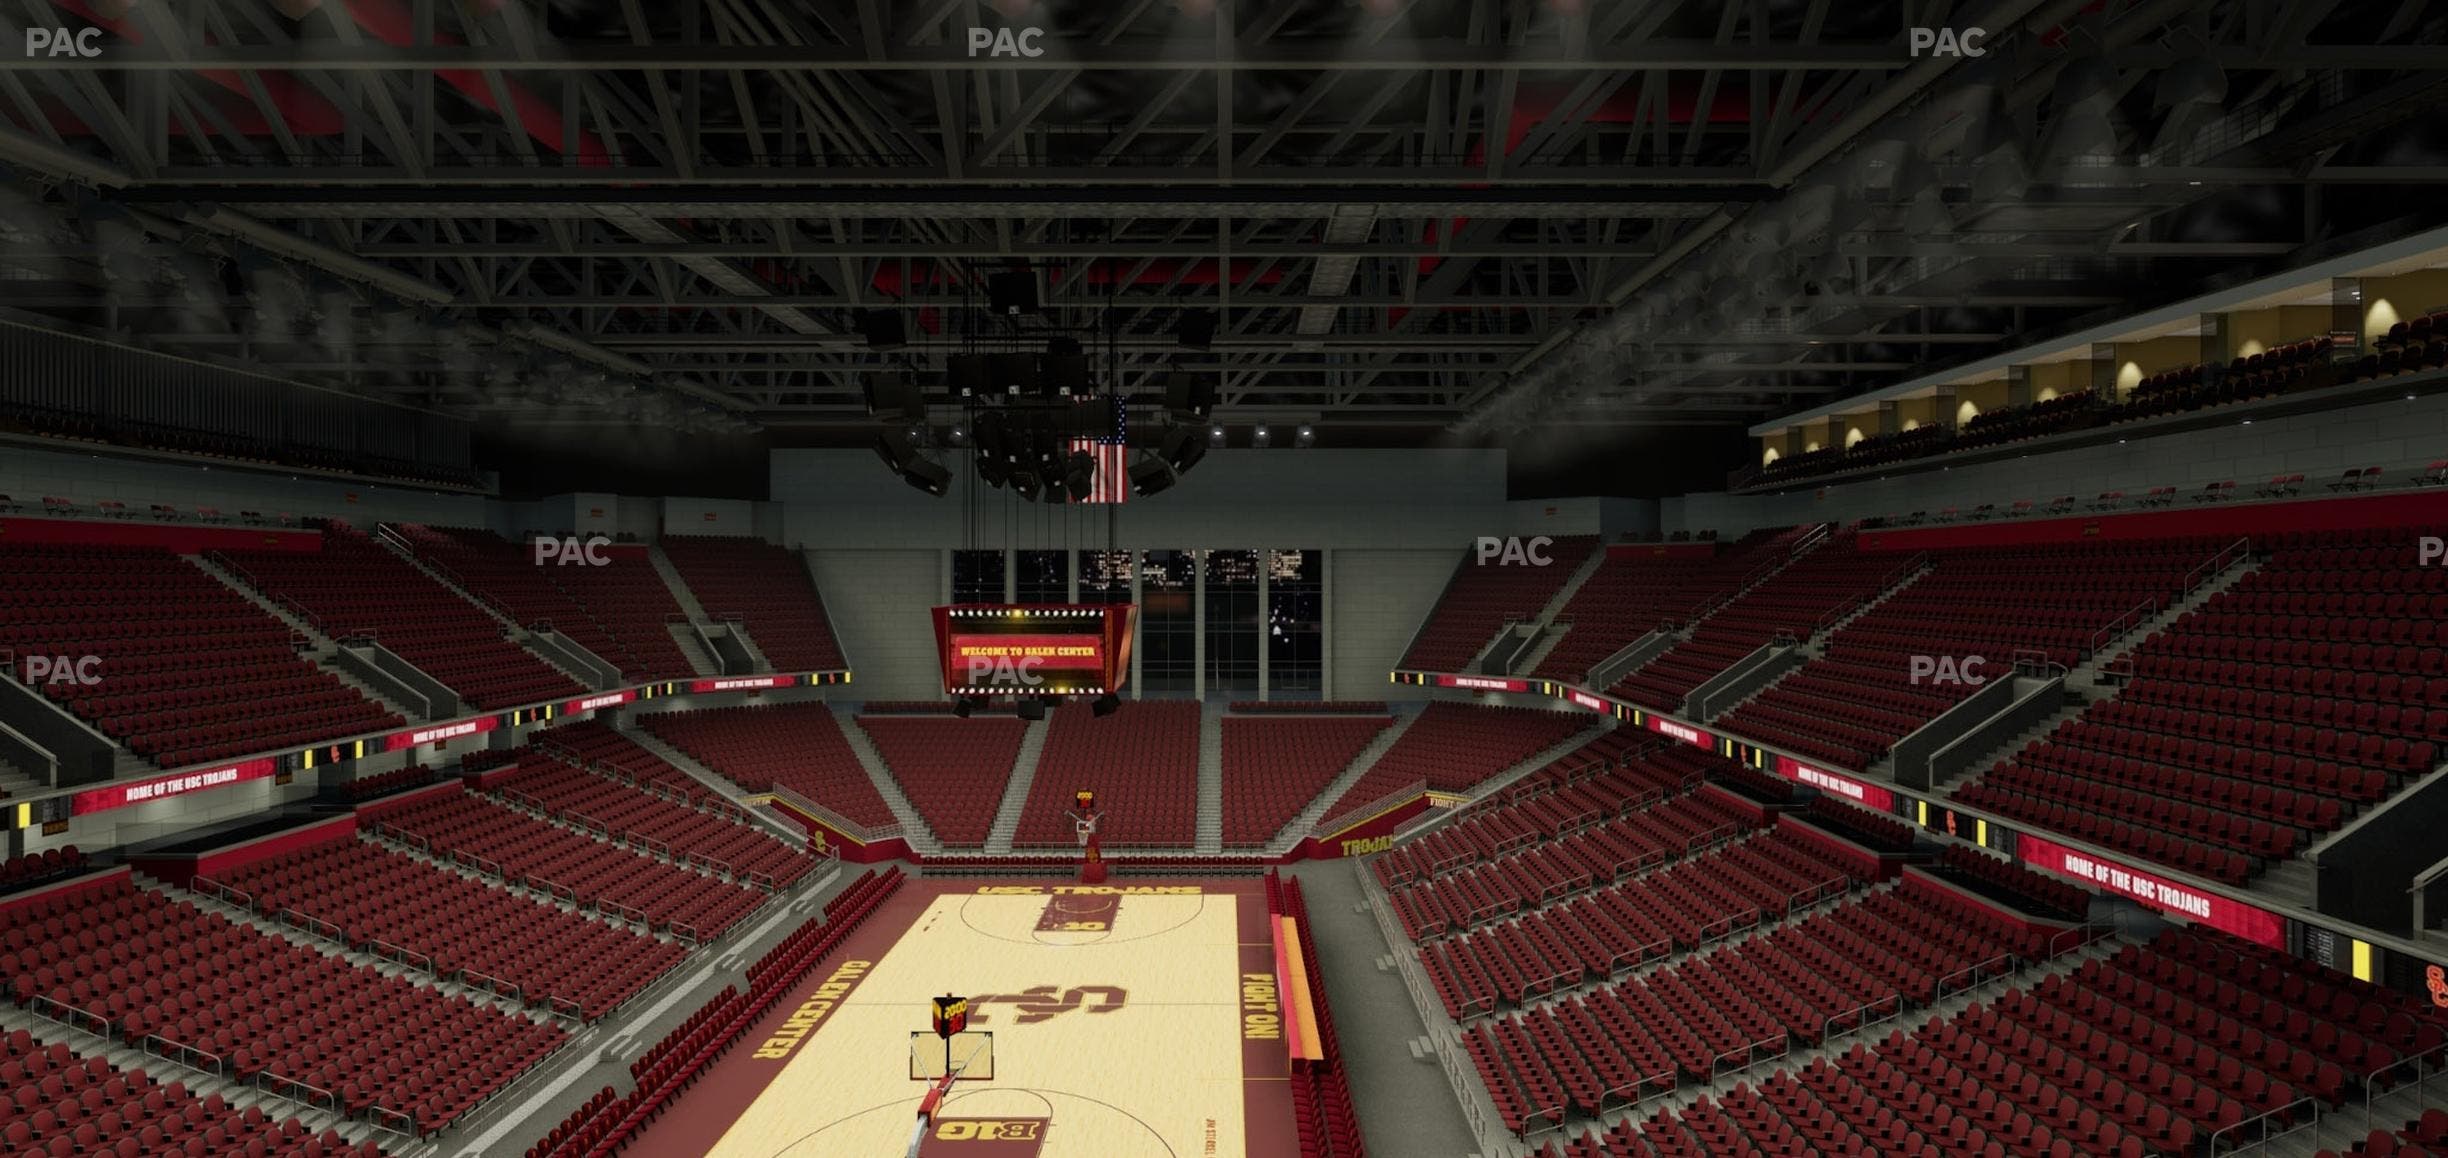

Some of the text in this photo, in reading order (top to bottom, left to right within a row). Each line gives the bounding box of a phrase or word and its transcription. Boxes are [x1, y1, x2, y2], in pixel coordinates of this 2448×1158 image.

[961, 647, 1095, 656] WELCOME TO GALEN CENTER
[126, 768, 238, 801] HOME OF THE USC TROJANS
[1053, 886, 1201, 895] TROJANS
[2065, 854, 2210, 918] HOME OF THE USC TROJANS
[752, 960, 871, 1059] GALEN CENTER
[1243, 974, 1279, 1039] FIGHT ON
